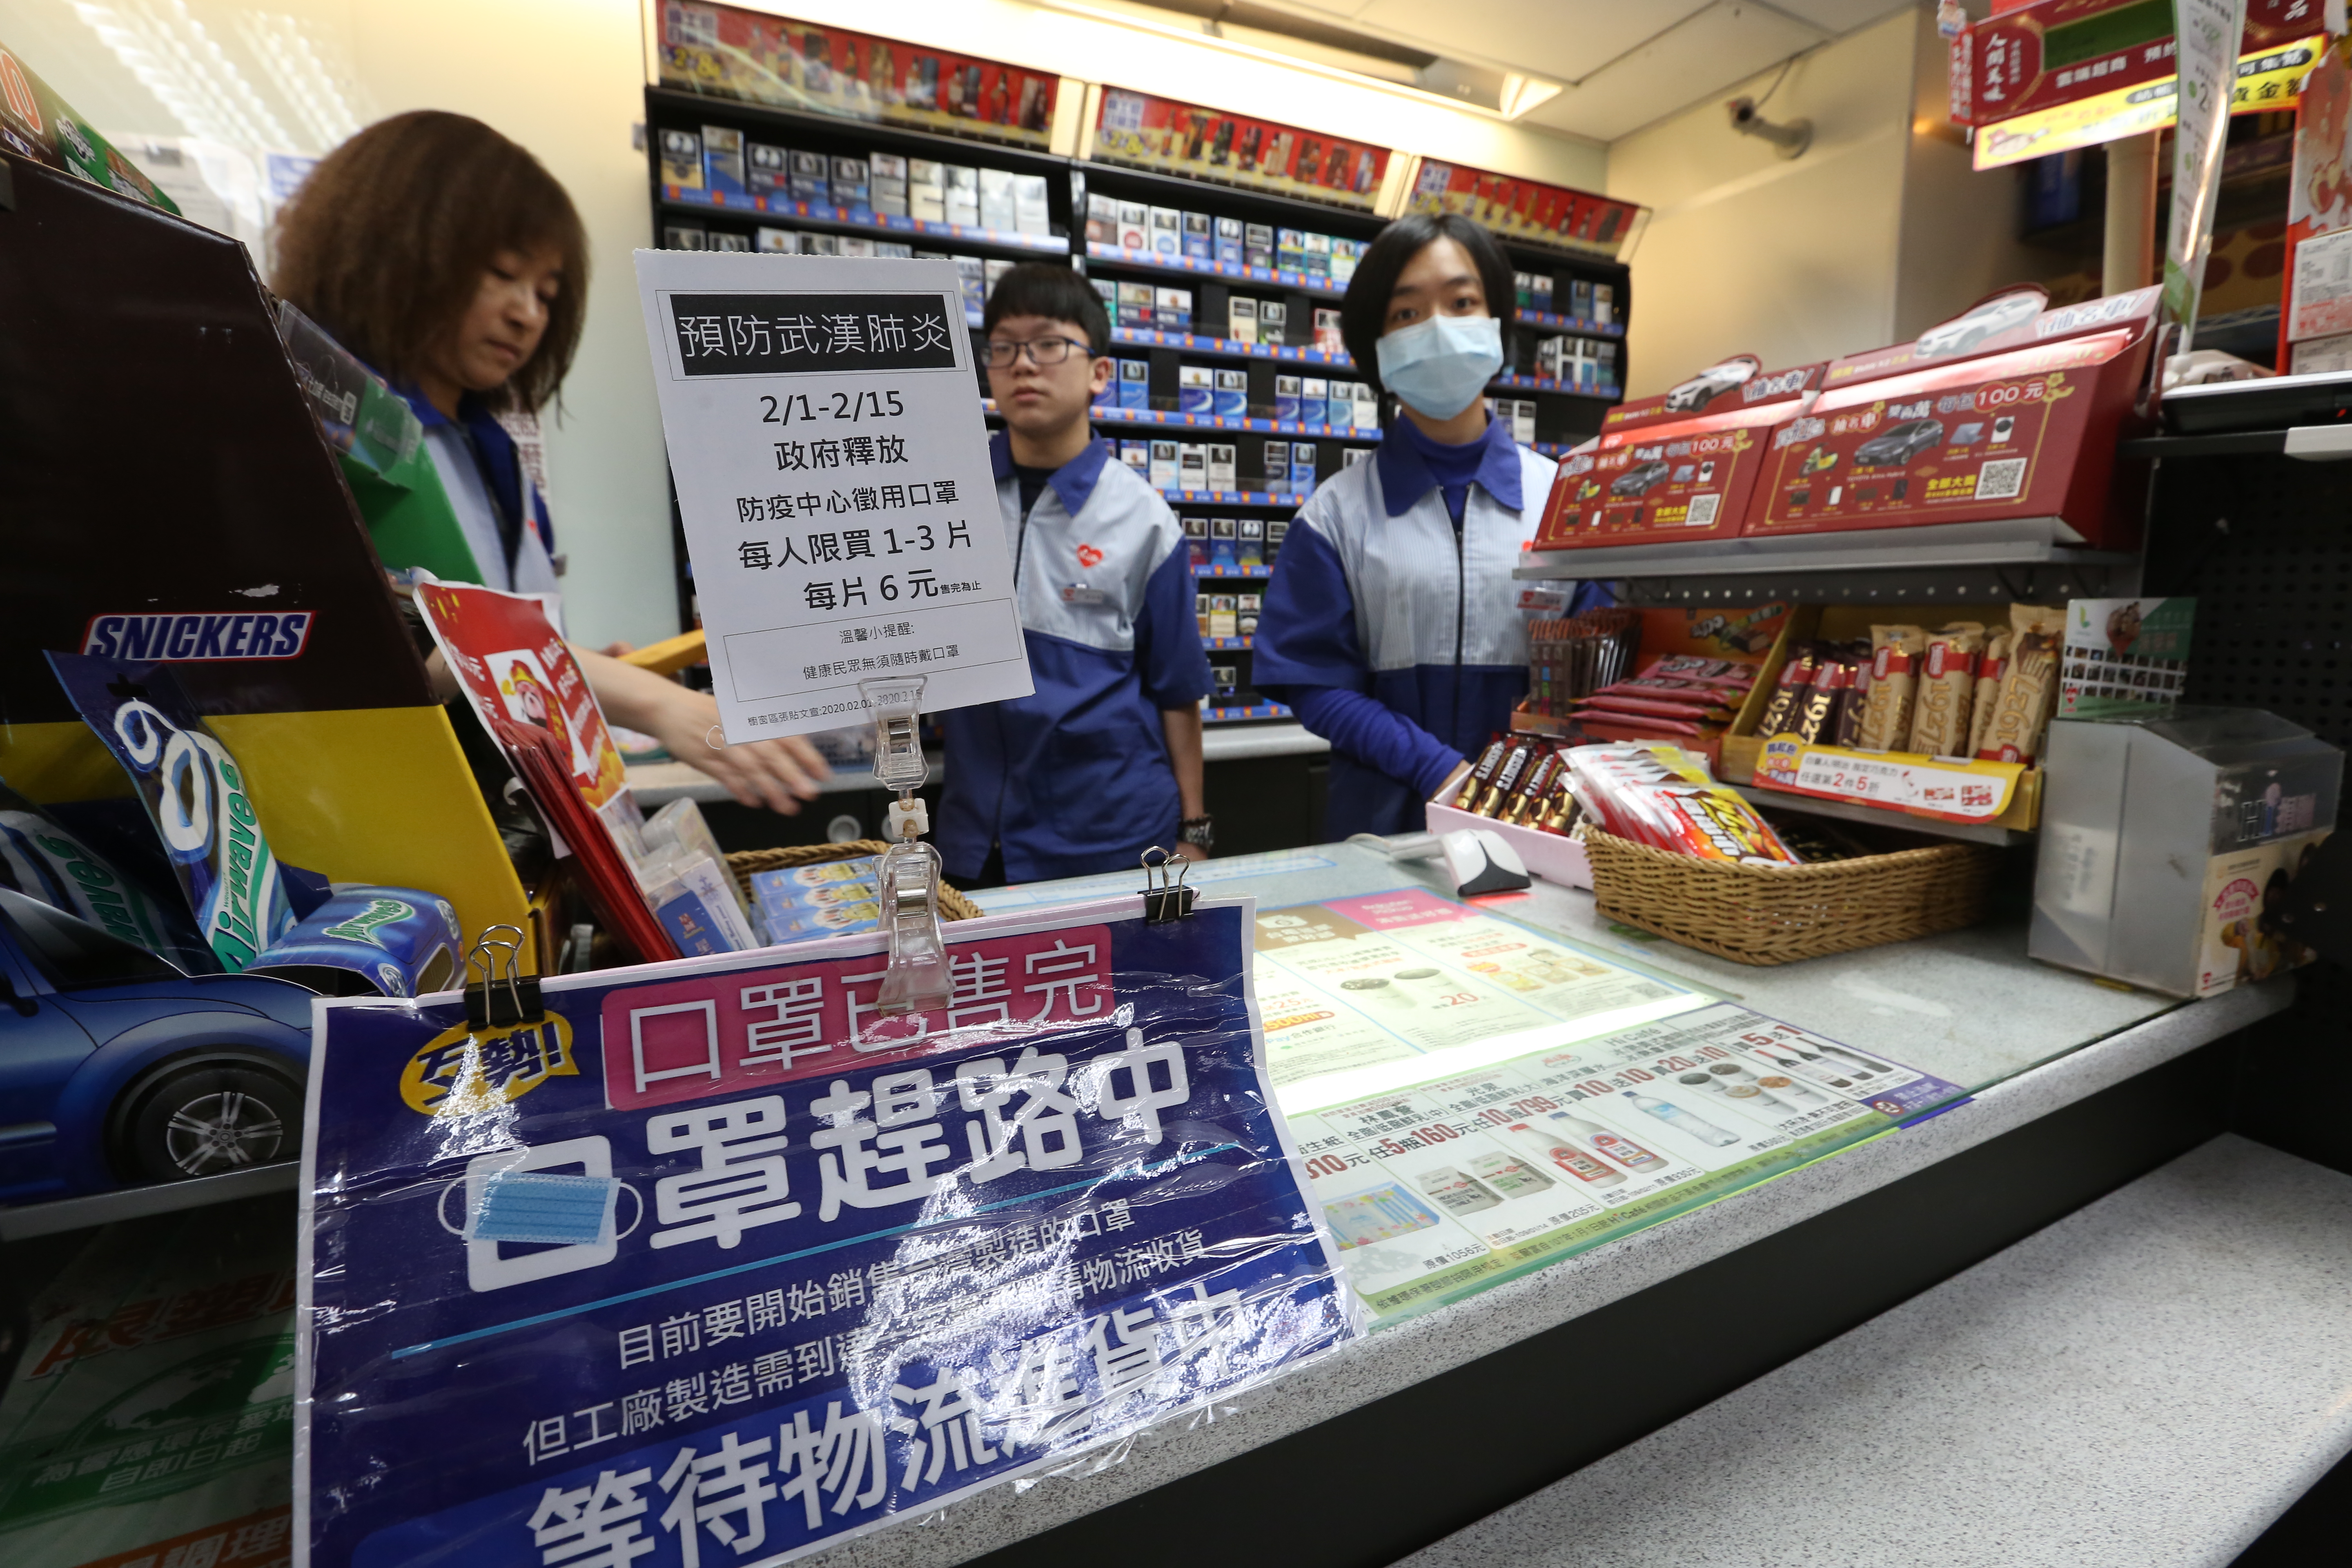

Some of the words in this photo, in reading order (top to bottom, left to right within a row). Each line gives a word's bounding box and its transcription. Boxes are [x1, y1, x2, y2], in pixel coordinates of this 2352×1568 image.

[679, 314, 952, 356] 預防武漢肺炎
[760, 390, 904, 424] 2/1-2/15
[774, 435, 908, 471] 政府釋放
[737, 481, 959, 522] 防疫中心徵用口罩
[738, 529, 876, 570] 每人限買
[887, 525, 935, 554] 1-3
[91, 614, 306, 659] SNICKERS
[803, 644, 959, 680] 健康民眾無須隨時戴口罩
[1996, 675, 2040, 741] 1927
[212, 757, 257, 973] Airwaves
[327, 900, 403, 940] Airwaves
[630, 938, 1102, 1093] 口罩已售完
[1650, 1046, 1729, 1076] 買20送10
[1566, 1068, 1655, 1101] 買10送10
[1348, 1107, 1450, 1140] 全脂/低脂鮮乳(中)
[1358, 1104, 1412, 1125] 林鳳營
[465, 1027, 1189, 1292] 口罩趕路中
[1368, 1120, 1478, 1160] 任5瓶160元
[1548, 1204, 1600, 1225] 原價205元
[1422, 1243, 1486, 1270] 原價1056元
